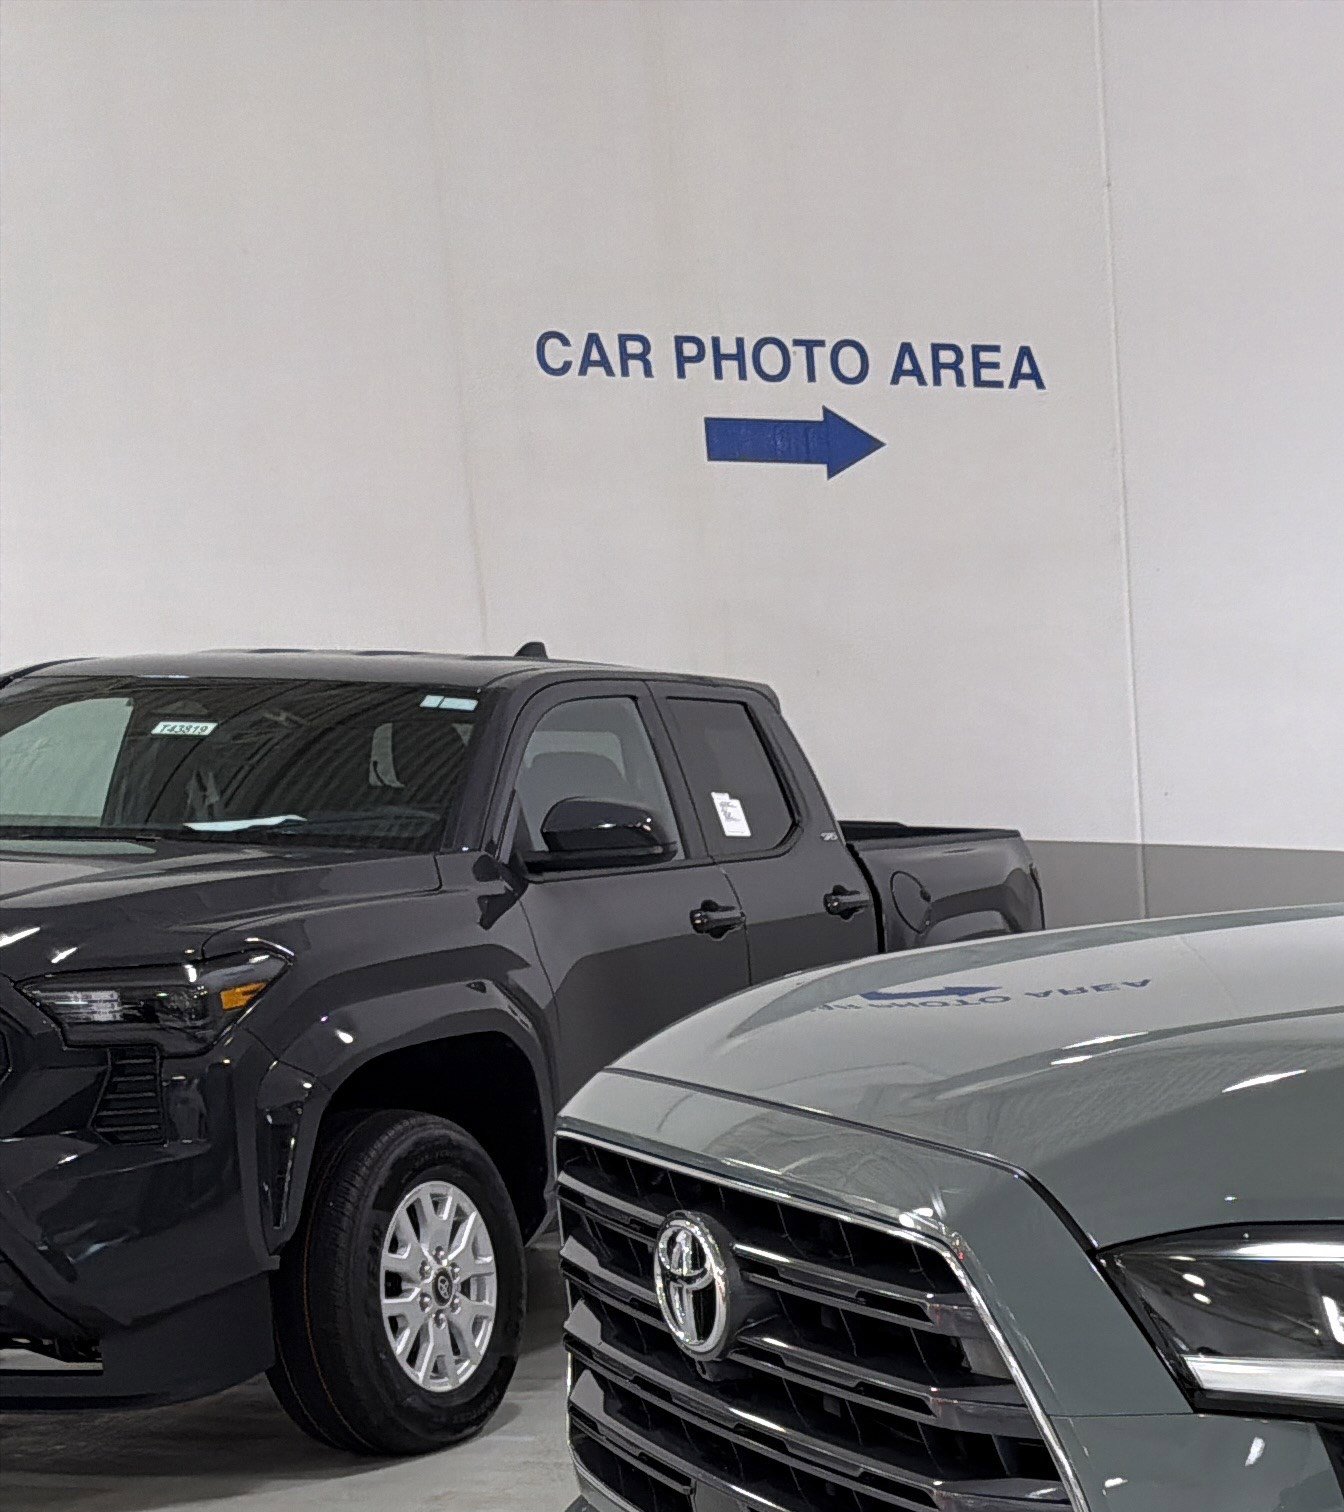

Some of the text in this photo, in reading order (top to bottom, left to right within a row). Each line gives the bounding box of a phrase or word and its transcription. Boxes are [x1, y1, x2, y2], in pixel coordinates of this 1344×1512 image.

[535, 331, 1048, 391] CAR PHOTO AREA
